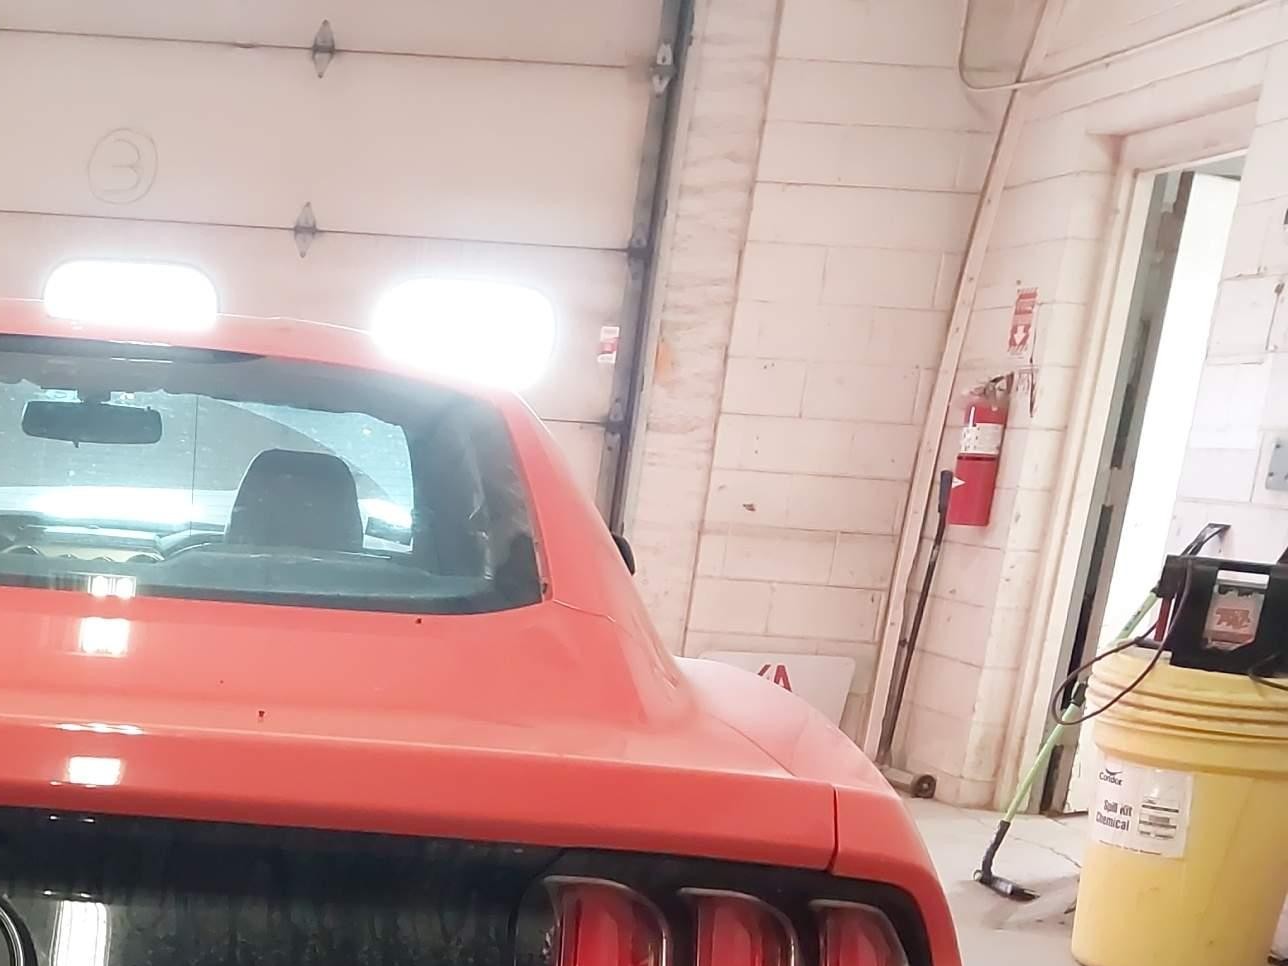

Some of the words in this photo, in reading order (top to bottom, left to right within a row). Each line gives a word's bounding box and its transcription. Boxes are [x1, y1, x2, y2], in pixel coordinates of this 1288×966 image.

[1104, 799, 1119, 813] Spill
[1119, 804, 1133, 817] Kit
[1096, 811, 1130, 831] Chemical
